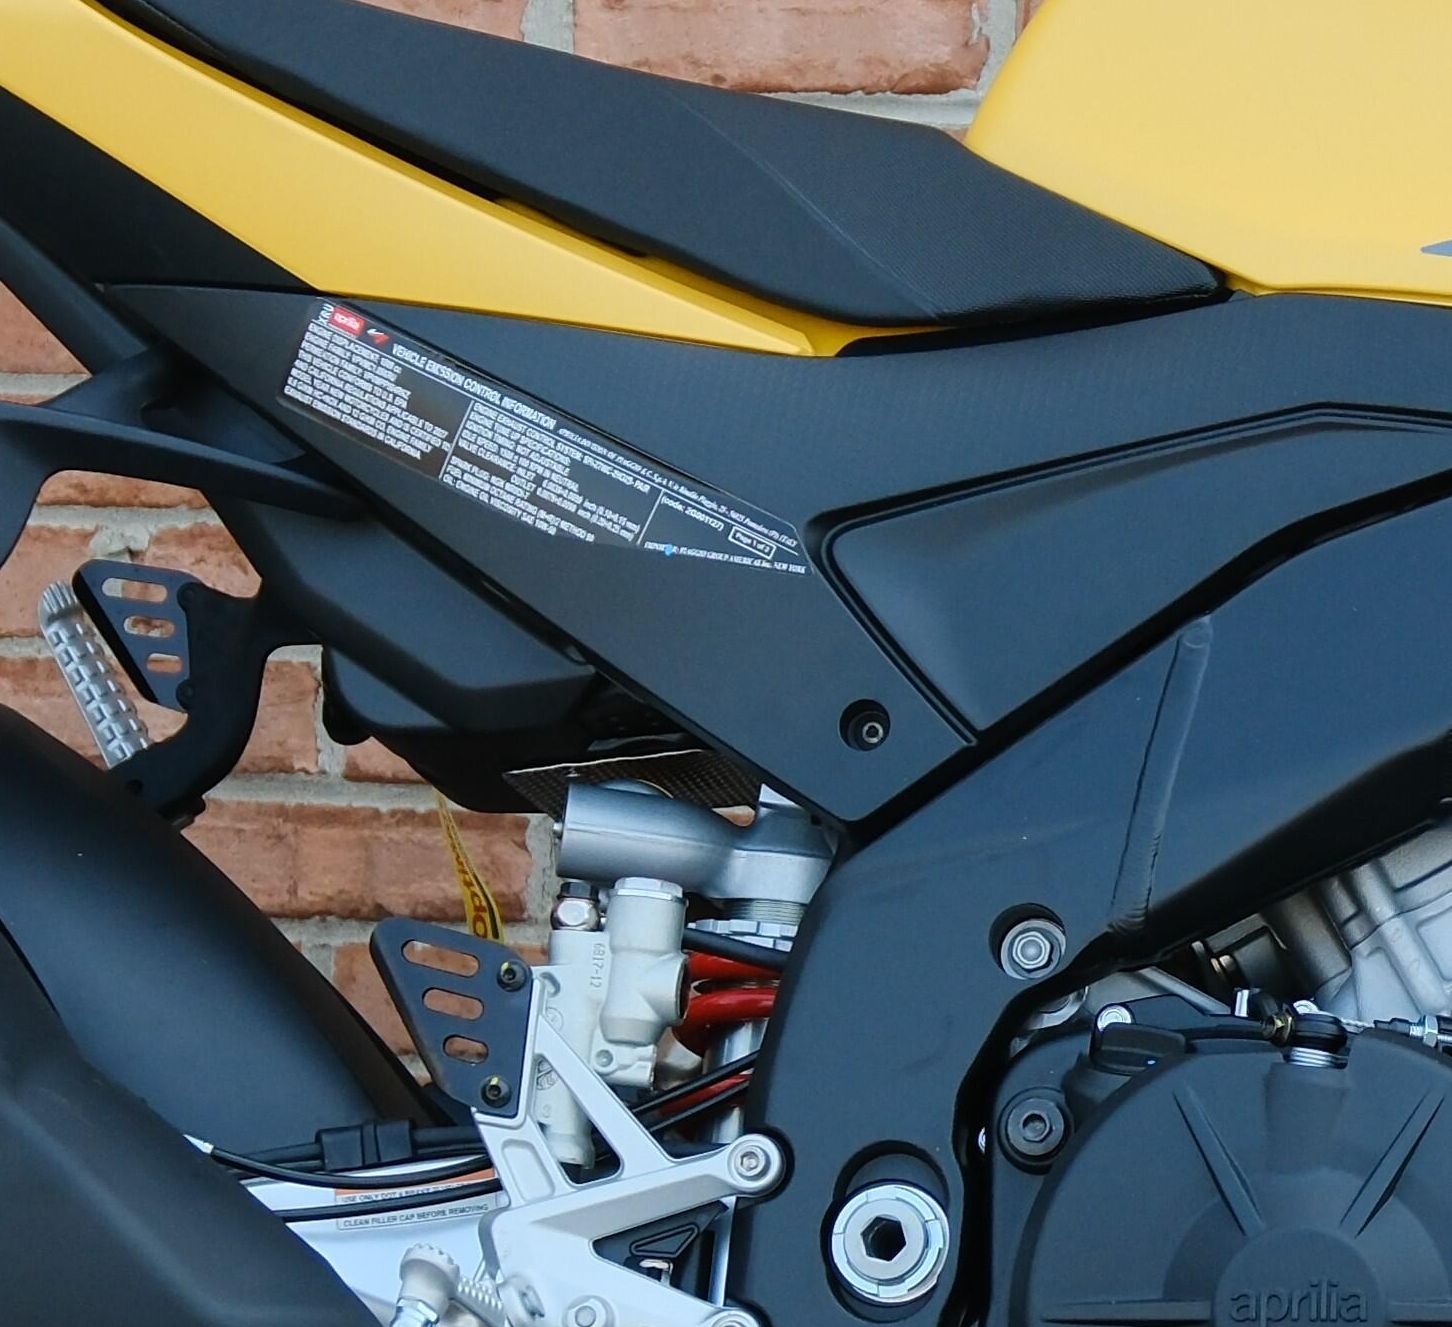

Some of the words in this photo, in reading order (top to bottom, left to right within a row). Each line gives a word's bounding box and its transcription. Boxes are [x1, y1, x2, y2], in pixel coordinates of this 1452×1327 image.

[306, 365, 345, 389] CALIFORNIA
[390, 343, 427, 368] VEHICLE
[423, 357, 465, 387] EMISSION
[462, 376, 504, 405] CONTROL
[500, 394, 557, 431] INFORMATION
[392, 395, 409, 409] EPA
[382, 434, 424, 460] CALIFORNIA
[343, 1218, 370, 1227] CLEAN
[371, 1215, 398, 1225] FILLER
[399, 1213, 415, 1222] CAP
[416, 1209, 447, 1220] BEFORE
[448, 1204, 489, 1216] REMOVING
